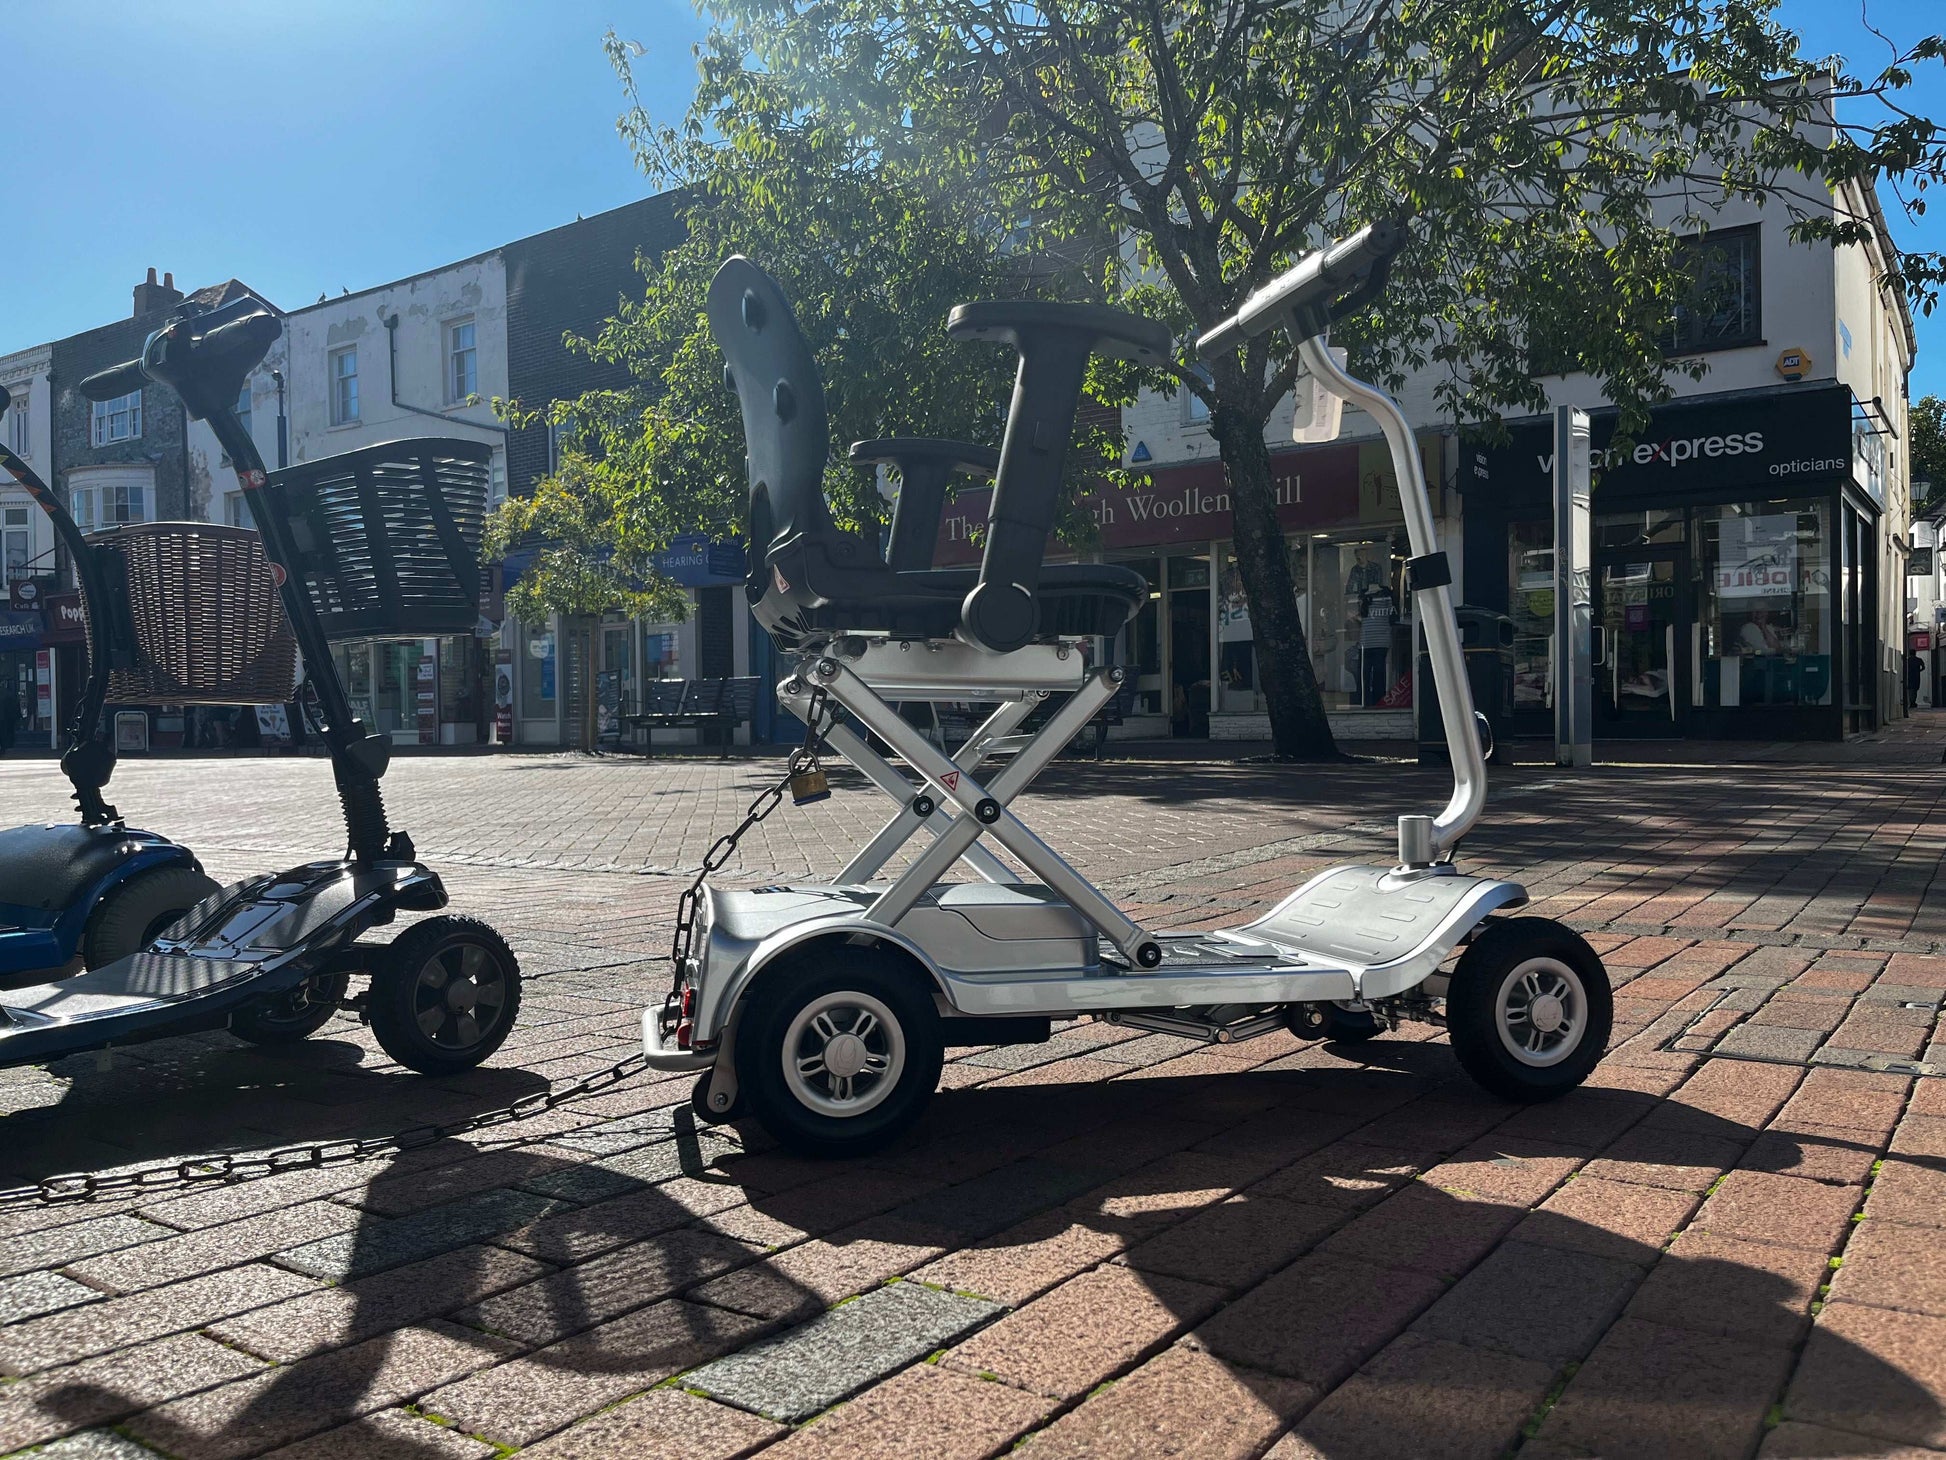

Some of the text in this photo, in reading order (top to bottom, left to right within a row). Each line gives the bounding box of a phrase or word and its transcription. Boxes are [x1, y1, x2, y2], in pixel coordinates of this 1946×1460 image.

[1783, 356, 1800, 367] ADT
[1537, 432, 1764, 473] von express
[1769, 457, 1845, 476] opticians
[945, 515, 985, 541] The
[1125, 489, 1231, 522] Woollen
[662, 554, 703, 569] HEARING
[0, 625, 26, 636] ESEARCH
[1383, 675, 1410, 706] SALE
